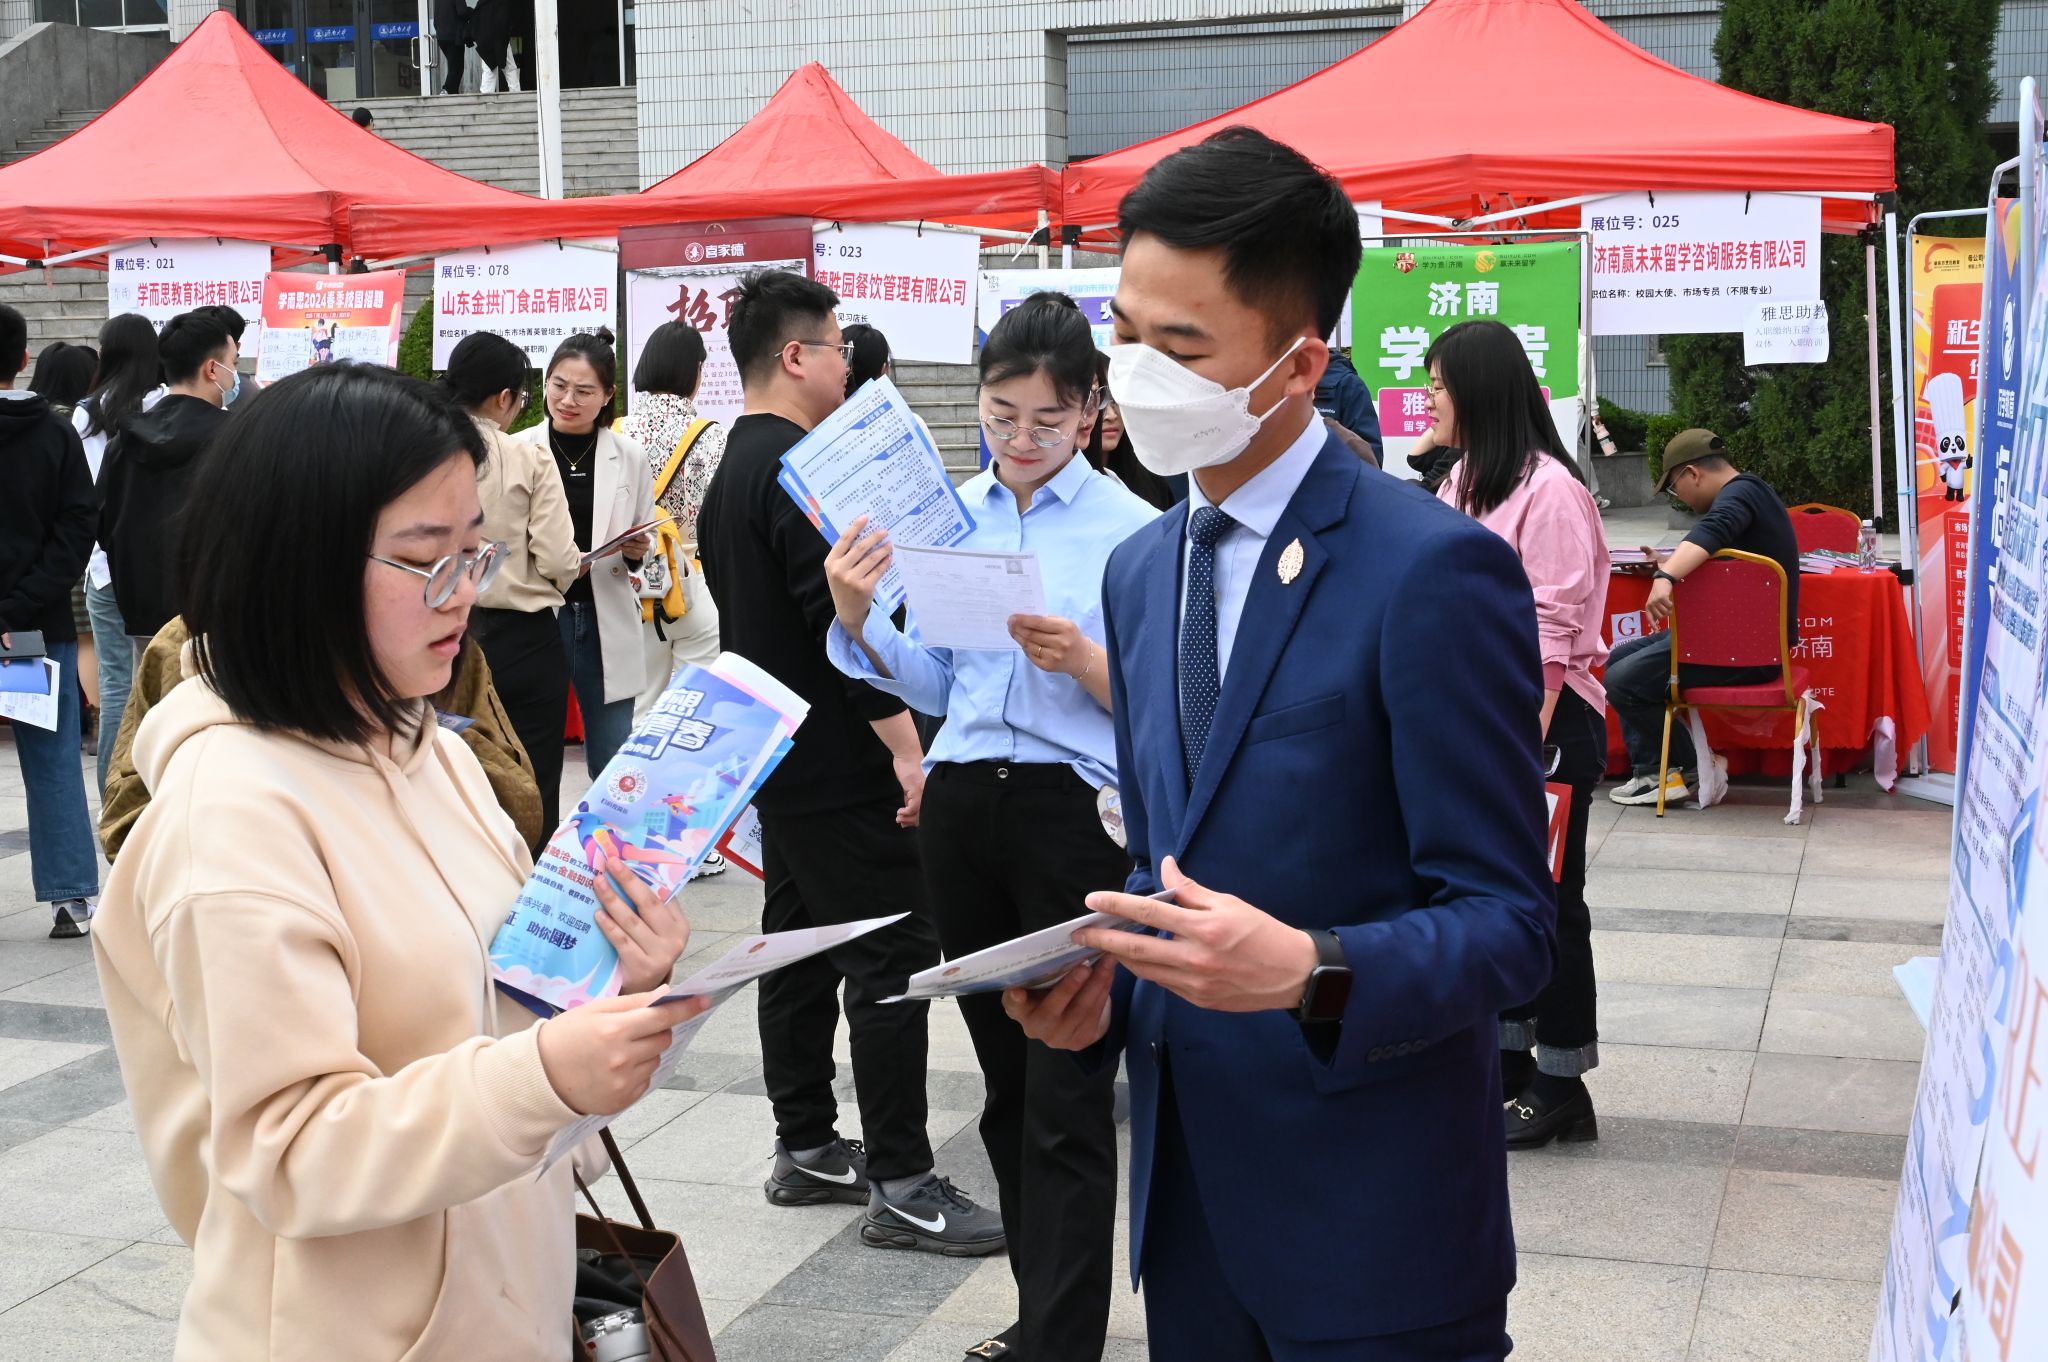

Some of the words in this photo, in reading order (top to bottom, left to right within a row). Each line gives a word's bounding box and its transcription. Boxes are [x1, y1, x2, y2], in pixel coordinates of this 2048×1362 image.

[705, 243, 745, 259] 喜家德
[1594, 239, 1806, 274] 济南赢未来留学咨询服务有限公司
[137, 280, 262, 307] 学而思教育科技有限公司
[278, 290, 384, 310] 学而思2024春季校园招聘
[441, 286, 608, 317] 山东金拱门食品有限公司
[1427, 280, 1500, 317] 济南
[1761, 304, 1826, 322] 雅思助教
[1379, 324, 1550, 381] 学贵
[1618, 616, 1636, 637] G
[1798, 617, 1833, 628] OM
